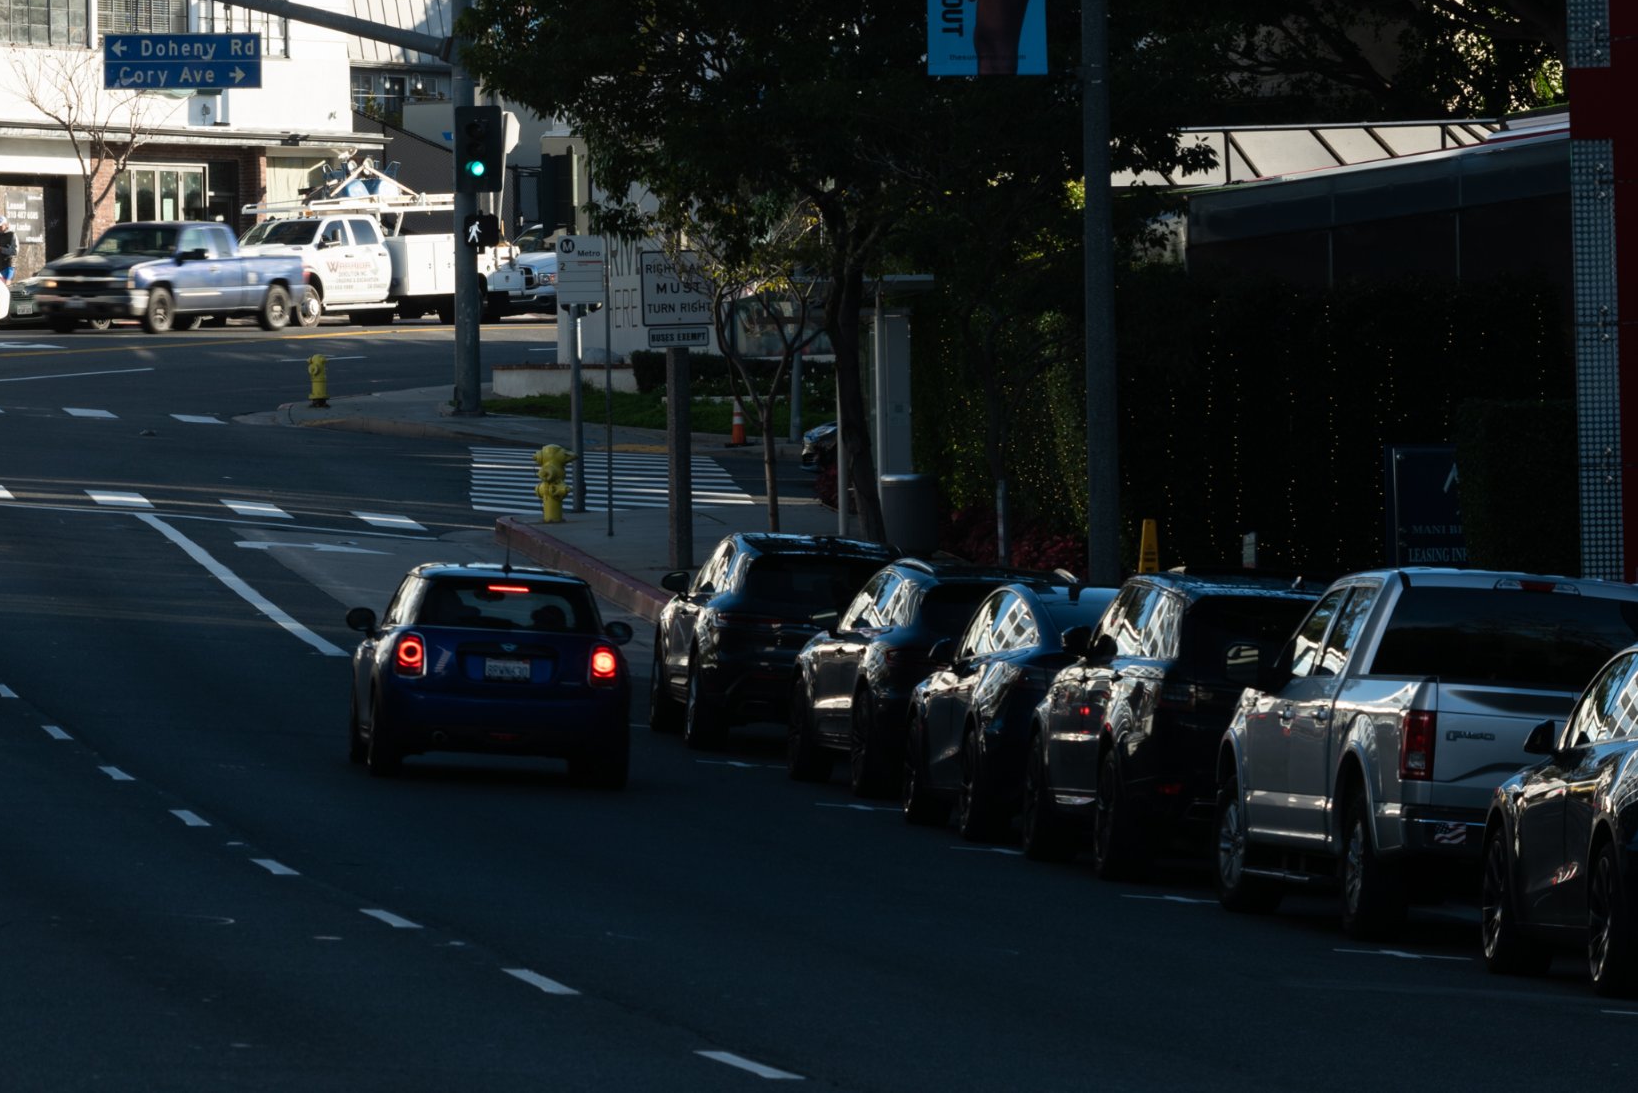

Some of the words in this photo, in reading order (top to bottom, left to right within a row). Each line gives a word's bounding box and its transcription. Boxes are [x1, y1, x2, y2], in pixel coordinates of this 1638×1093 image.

[141, 39, 216, 59] Doheny
[231, 39, 255, 56] Rd
[120, 66, 168, 87] Cory
[179, 66, 215, 83] Ave
[560, 262, 566, 271] 2
[656, 282, 700, 294] MUST
[647, 303, 675, 314] TURN
[680, 301, 711, 313] RIGHT
[651, 333, 675, 342] BUSES
[677, 332, 706, 341] EXEMPT
[1408, 547, 1450, 563] LEASING
